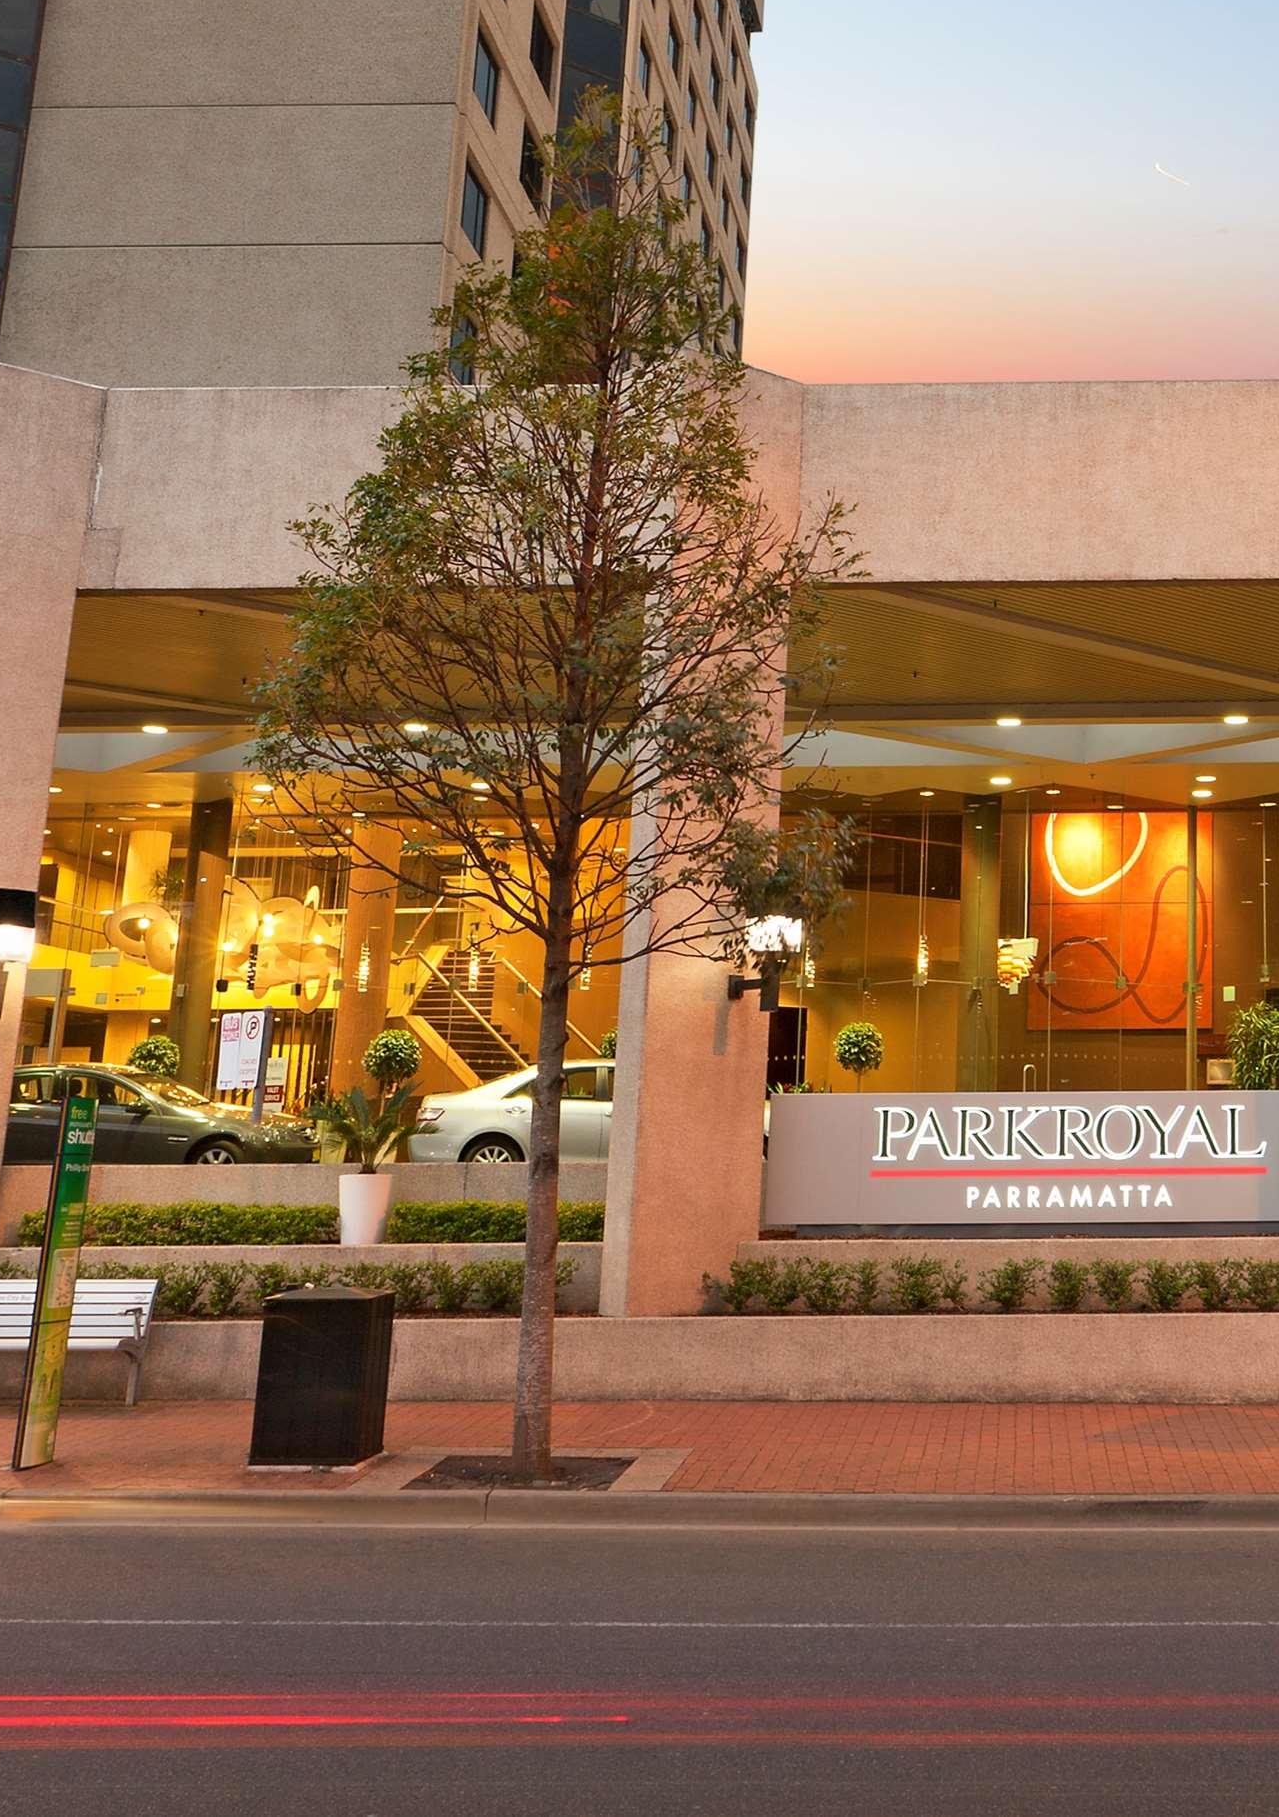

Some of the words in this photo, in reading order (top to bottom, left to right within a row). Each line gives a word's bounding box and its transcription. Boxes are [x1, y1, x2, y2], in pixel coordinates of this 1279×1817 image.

[71, 1106, 88, 1119] free
[872, 1105, 1267, 1161] PARKROYAL
[966, 1183, 1174, 1209] PARRAMATTA
